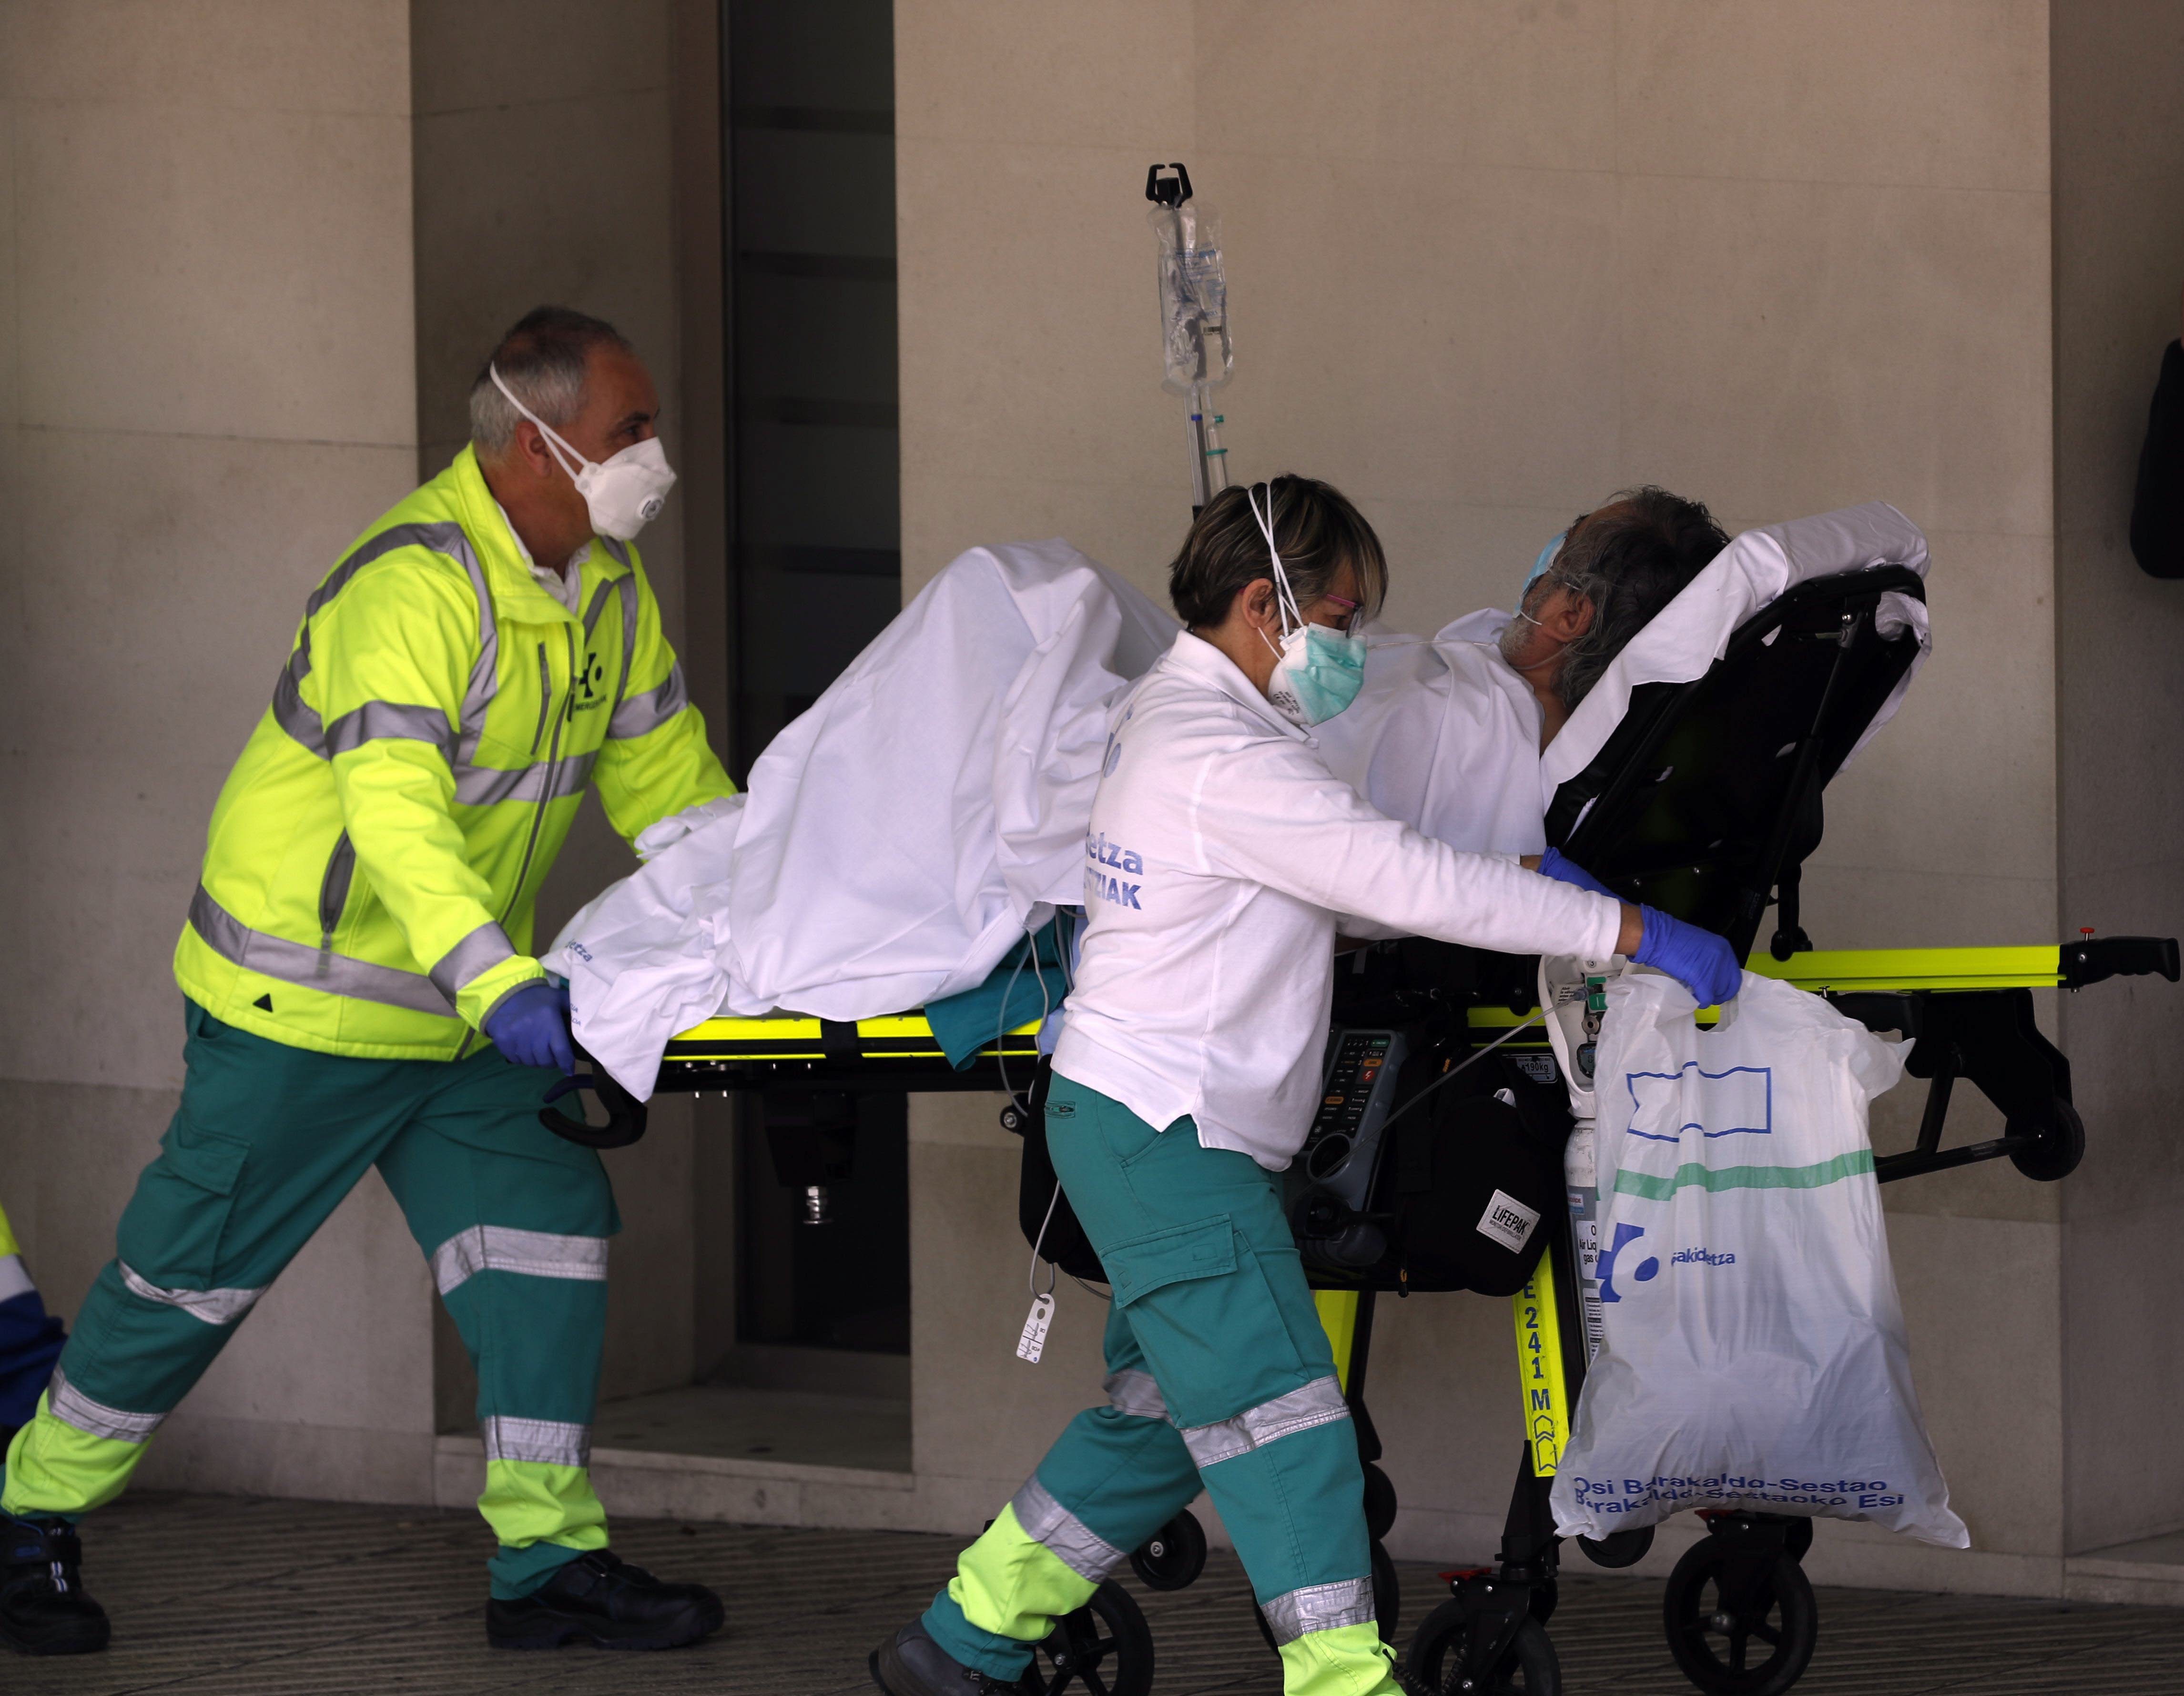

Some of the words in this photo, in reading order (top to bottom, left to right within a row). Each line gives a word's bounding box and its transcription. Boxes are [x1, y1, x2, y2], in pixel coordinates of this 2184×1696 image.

[1086, 829, 1143, 875] etza
[1525, 1062, 1548, 1073] 190kg
[1492, 1205, 1529, 1235] LIFEPAK
[1583, 1254, 1594, 1265] gas
[1859, 1494, 1904, 1508] Esi
